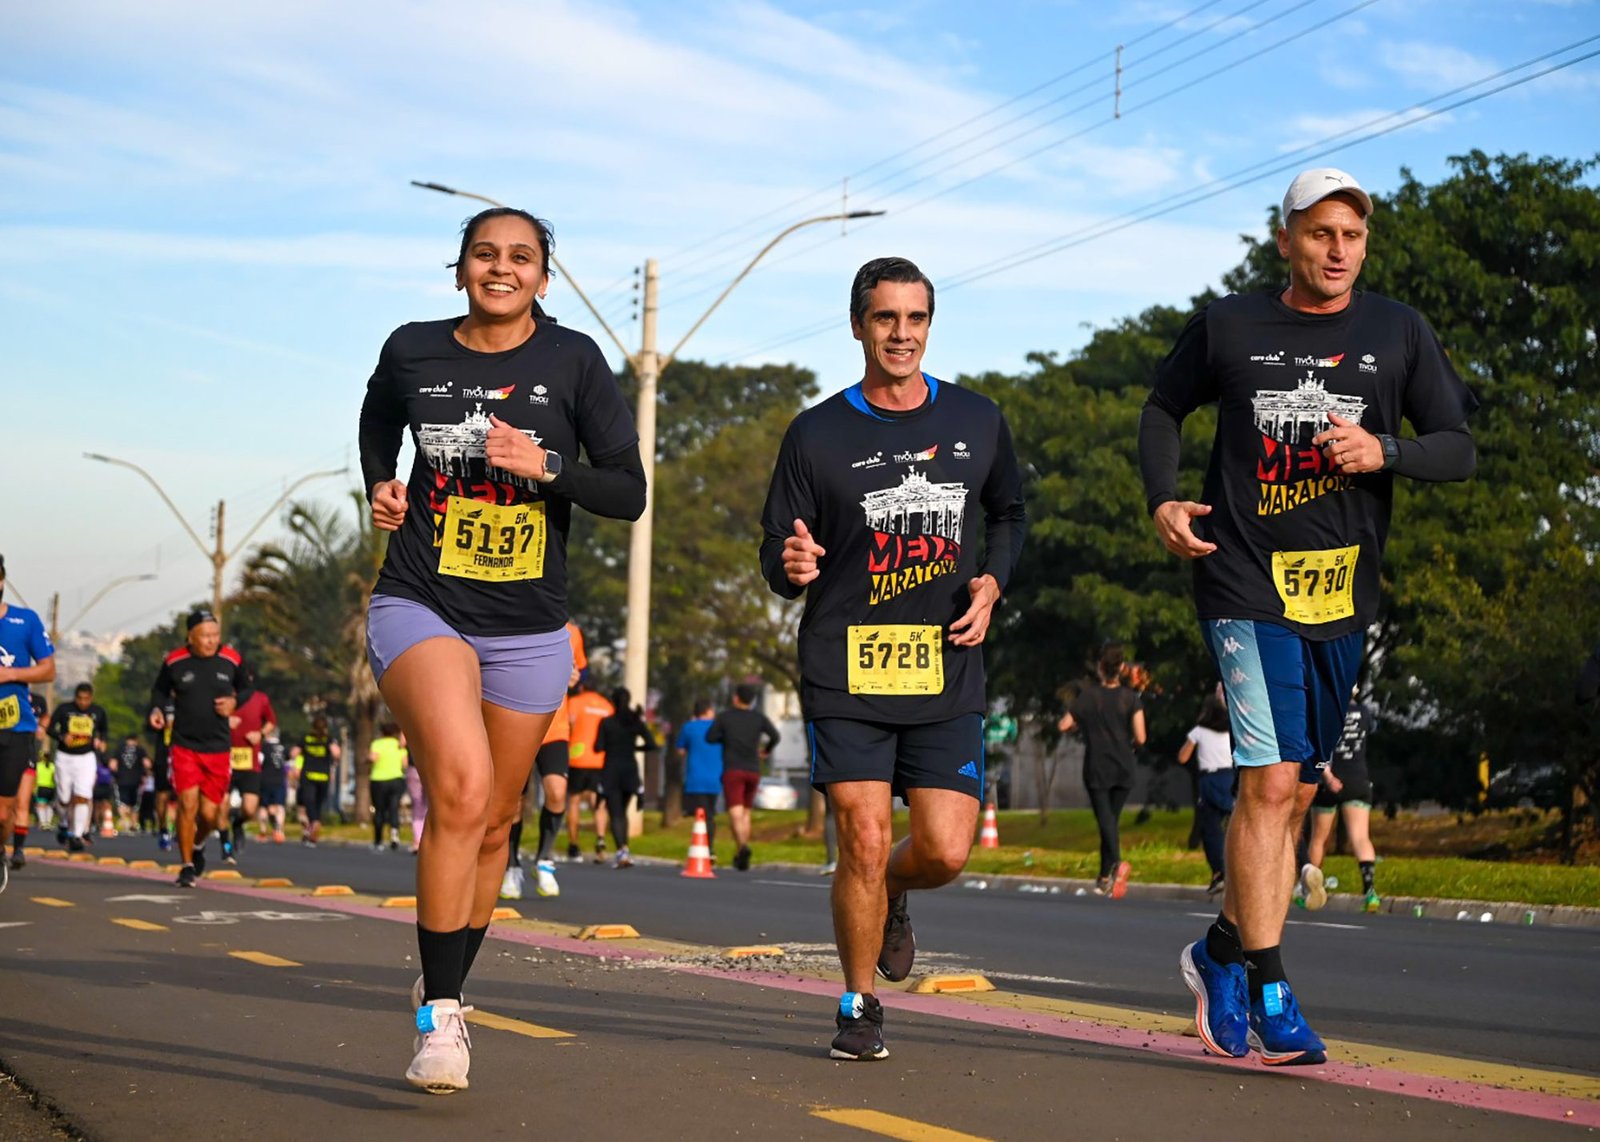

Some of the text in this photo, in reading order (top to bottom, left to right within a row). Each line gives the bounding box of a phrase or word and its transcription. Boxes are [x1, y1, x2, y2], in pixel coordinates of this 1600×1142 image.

[515, 512, 529, 524] 5K
[456, 518, 535, 555] 5137
[474, 554, 514, 568] FERNANDA
[1334, 555, 1346, 566] 5K
[1284, 565, 1348, 597] 5730
[909, 631, 923, 642] 5K
[859, 643, 930, 669] 5728
